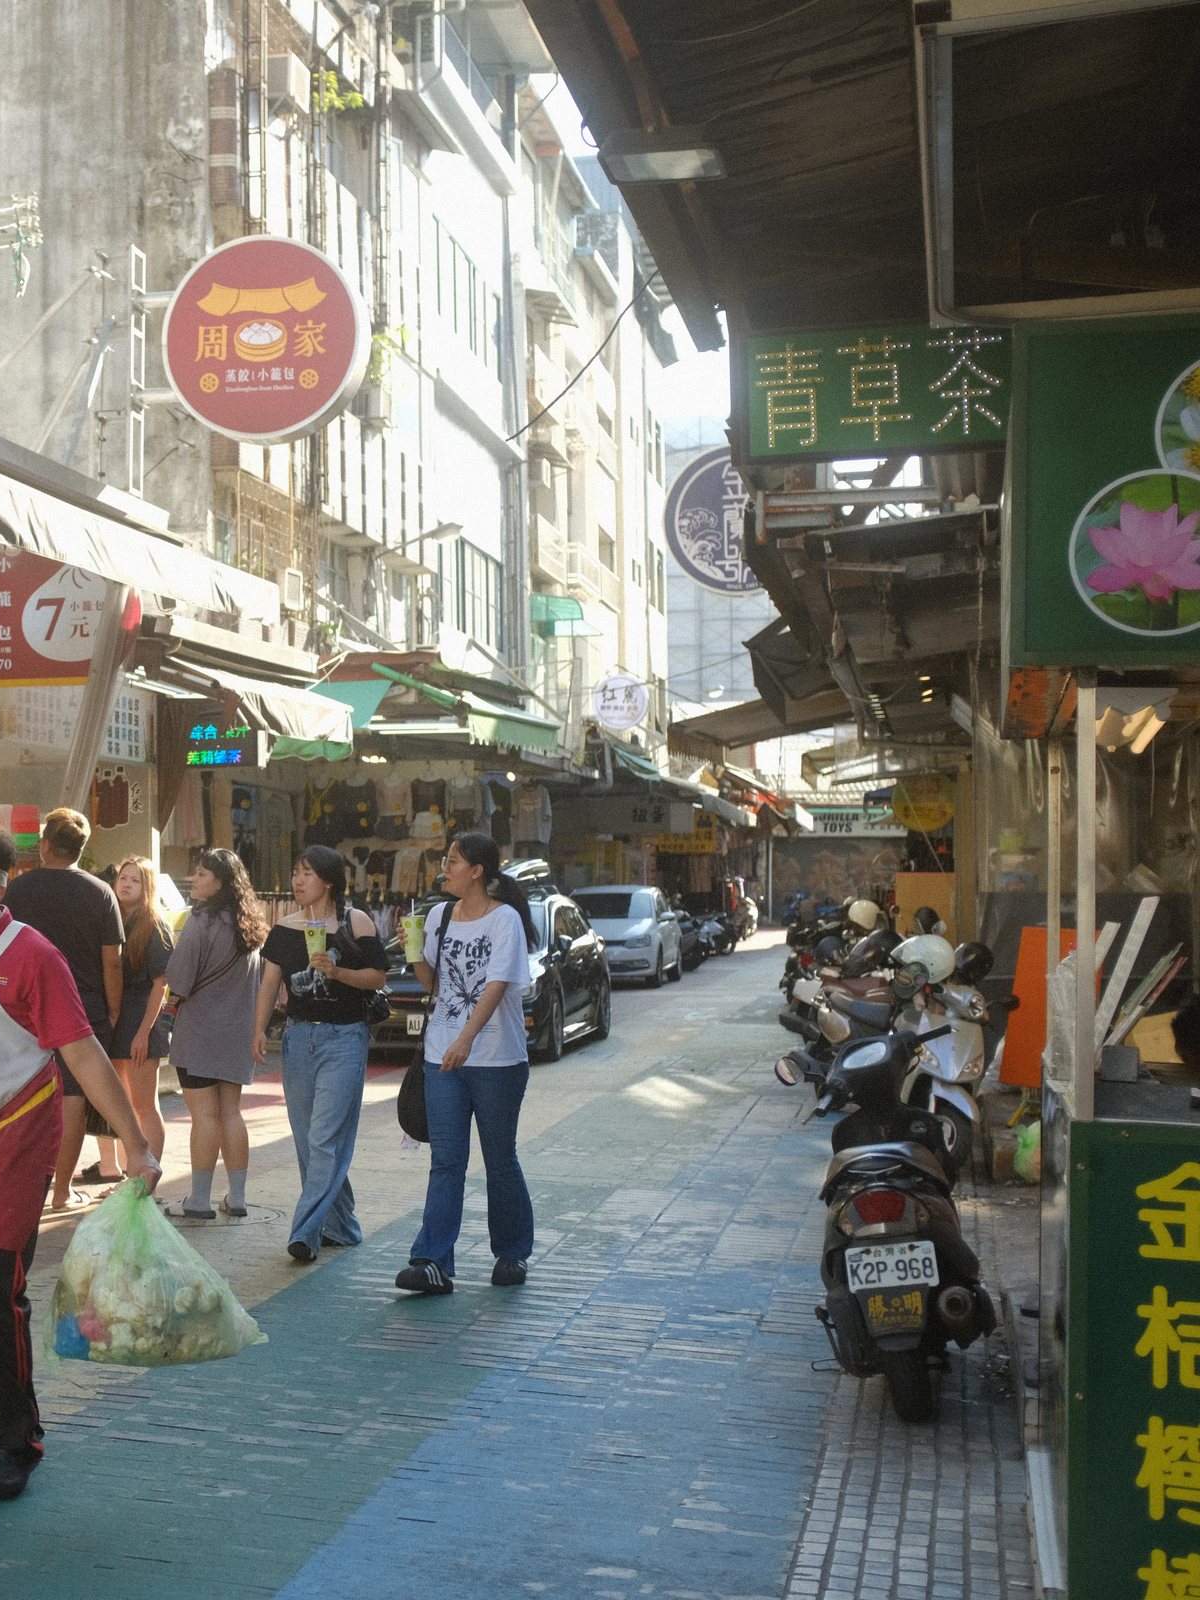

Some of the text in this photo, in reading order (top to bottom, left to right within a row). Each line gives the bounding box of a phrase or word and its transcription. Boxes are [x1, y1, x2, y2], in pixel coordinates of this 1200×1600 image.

[194, 319, 327, 362] 周 家
[755, 330, 1002, 447] 青草茶
[35, 597, 65, 641] 7
[824, 822, 852, 833] TOYS
[850, 1257, 934, 1285] K2P-968
